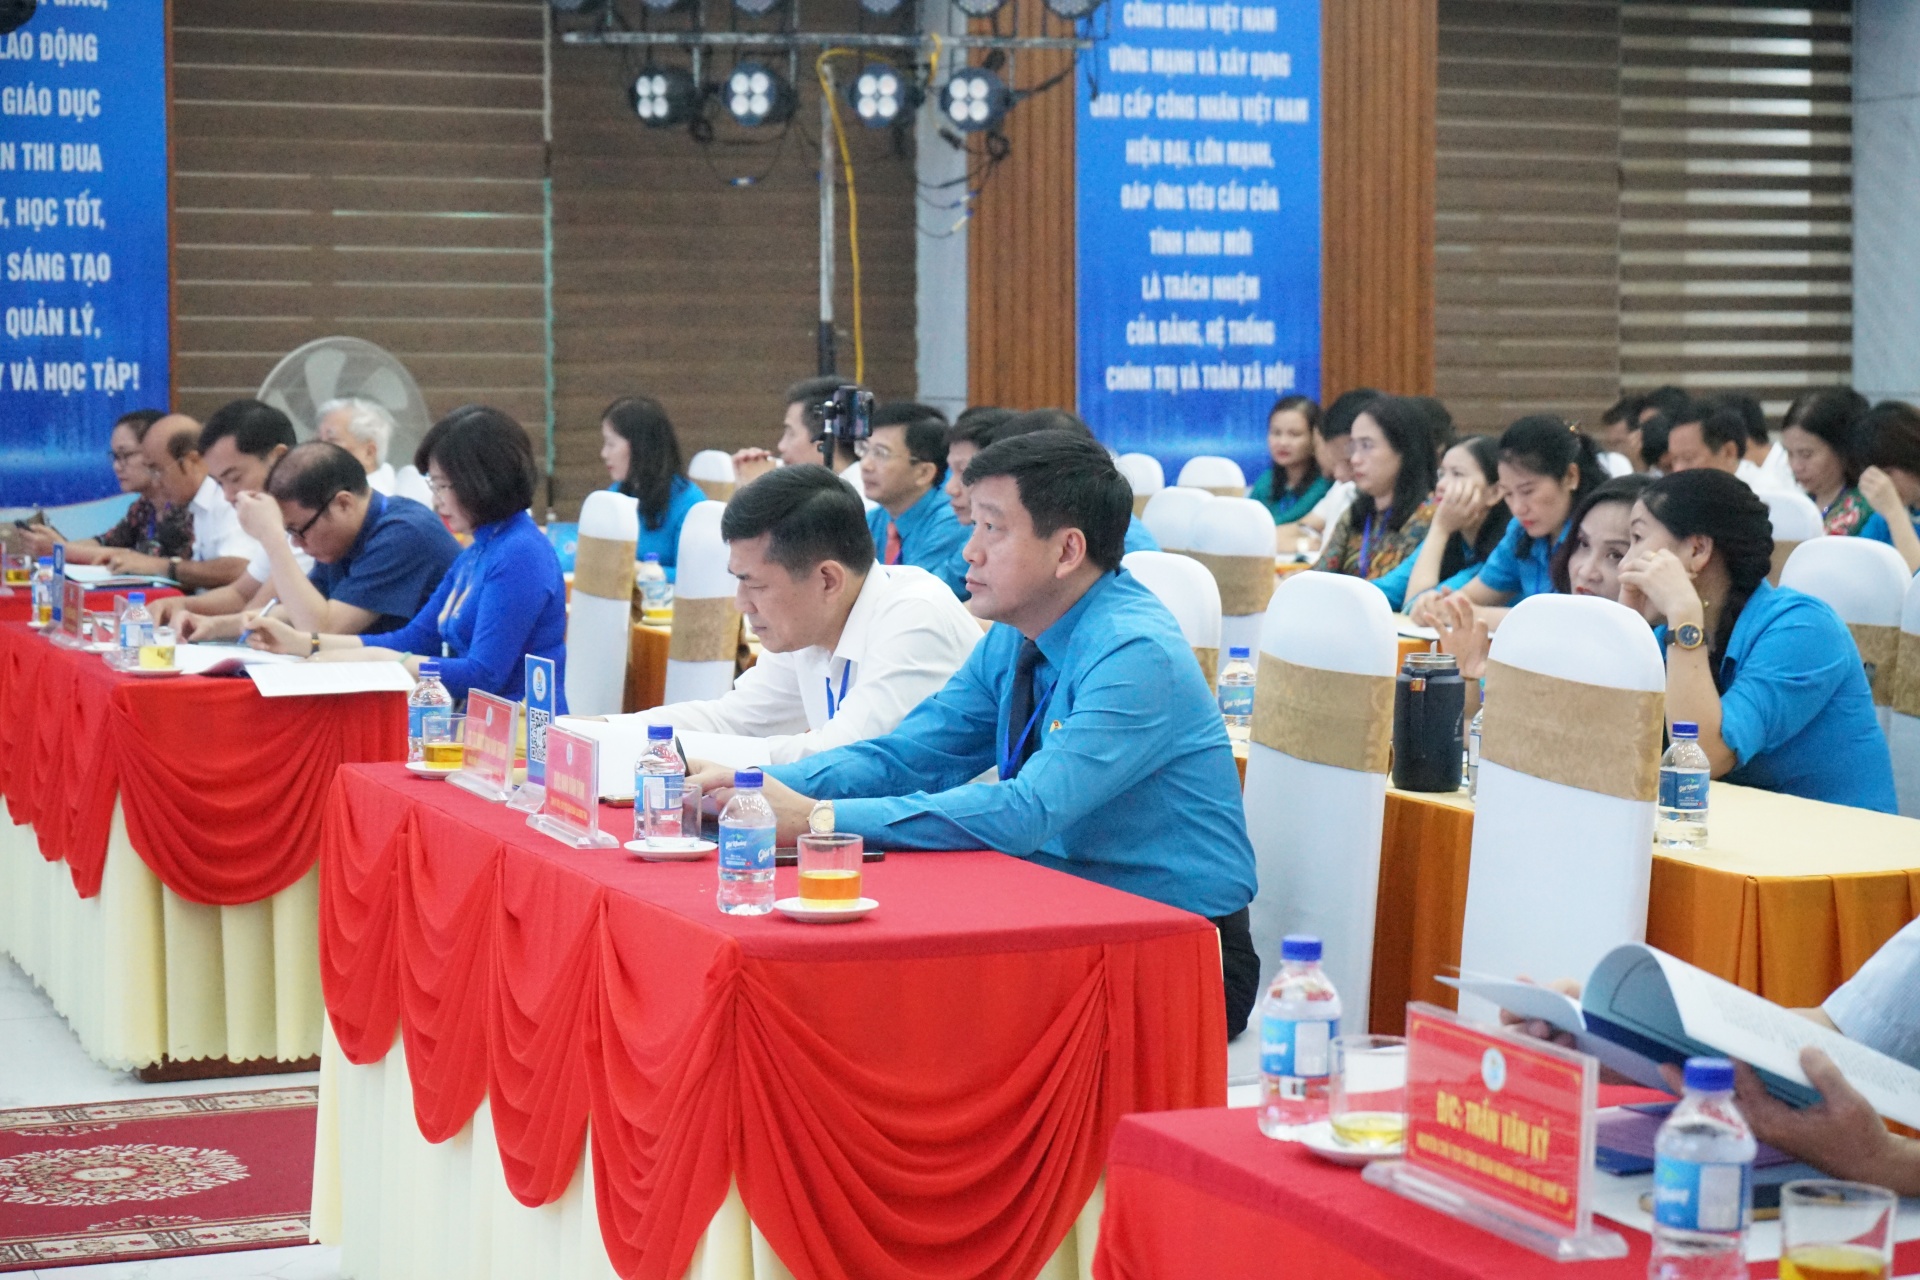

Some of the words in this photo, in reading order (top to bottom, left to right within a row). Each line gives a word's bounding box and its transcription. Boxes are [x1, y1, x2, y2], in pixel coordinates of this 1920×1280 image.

[1123, 0, 1165, 29] CÔNG
[1165, 0, 1208, 31] ĐOÀN
[1208, 1, 1241, 35] VIỆT
[1241, 6, 1278, 33] NAM
[40, 28, 97, 67] ĐỘNG
[1109, 43, 1150, 74] VỮNG
[1150, 48, 1197, 78] MẠNH
[1197, 45, 1218, 76] VÀ
[1218, 47, 1249, 76] XÂY
[1249, 51, 1291, 82] DỰNG
[3, 82, 52, 116] GIÁO
[58, 89, 100, 122] DỤC
[1121, 87, 1154, 119] CẤP
[1155, 89, 1197, 120] CÔNG
[1197, 91, 1241, 122] NHÂN
[1241, 92, 1273, 126] VIỆT
[1274, 97, 1309, 124] NAM
[22, 143, 54, 171] THI
[61, 143, 102, 172] ĐUA
[1126, 135, 1162, 169] HIỆN
[1162, 139, 1195, 169] ĐẠI,
[1195, 137, 1226, 166] LỚN
[1226, 141, 1274, 171] MẠNH,
[16, 198, 58, 232] HỌC
[64, 190, 105, 229] TỐT,
[1120, 181, 1153, 210] ĐÁP
[1187, 181, 1217, 211] YÊU
[1217, 179, 1249, 212] CẦU
[1249, 180, 1280, 212] CỦA
[7, 248, 65, 281] SÁNG
[71, 253, 111, 287] TẠO
[1142, 271, 1162, 301] LÀ
[1163, 271, 1212, 301] TRÁCH
[1211, 272, 1260, 305] NHIỆM
[6, 299, 64, 339] QUẢN
[70, 303, 101, 338] LÝ,
[1126, 313, 1158, 346] CỦA
[1158, 313, 1205, 348] ĐẢNG,
[1204, 316, 1226, 351] HỆ
[1227, 314, 1276, 346] THỐNG
[10, 357, 38, 390] VÀ
[44, 362, 86, 396] HỌC
[92, 357, 139, 396] TẬP!
[1105, 361, 1153, 392] CHÍNH
[1153, 365, 1179, 395] TRỊ
[1179, 361, 1201, 391] VÀ
[1201, 360, 1241, 390] TOÀN
[1241, 360, 1264, 391] XÃ
